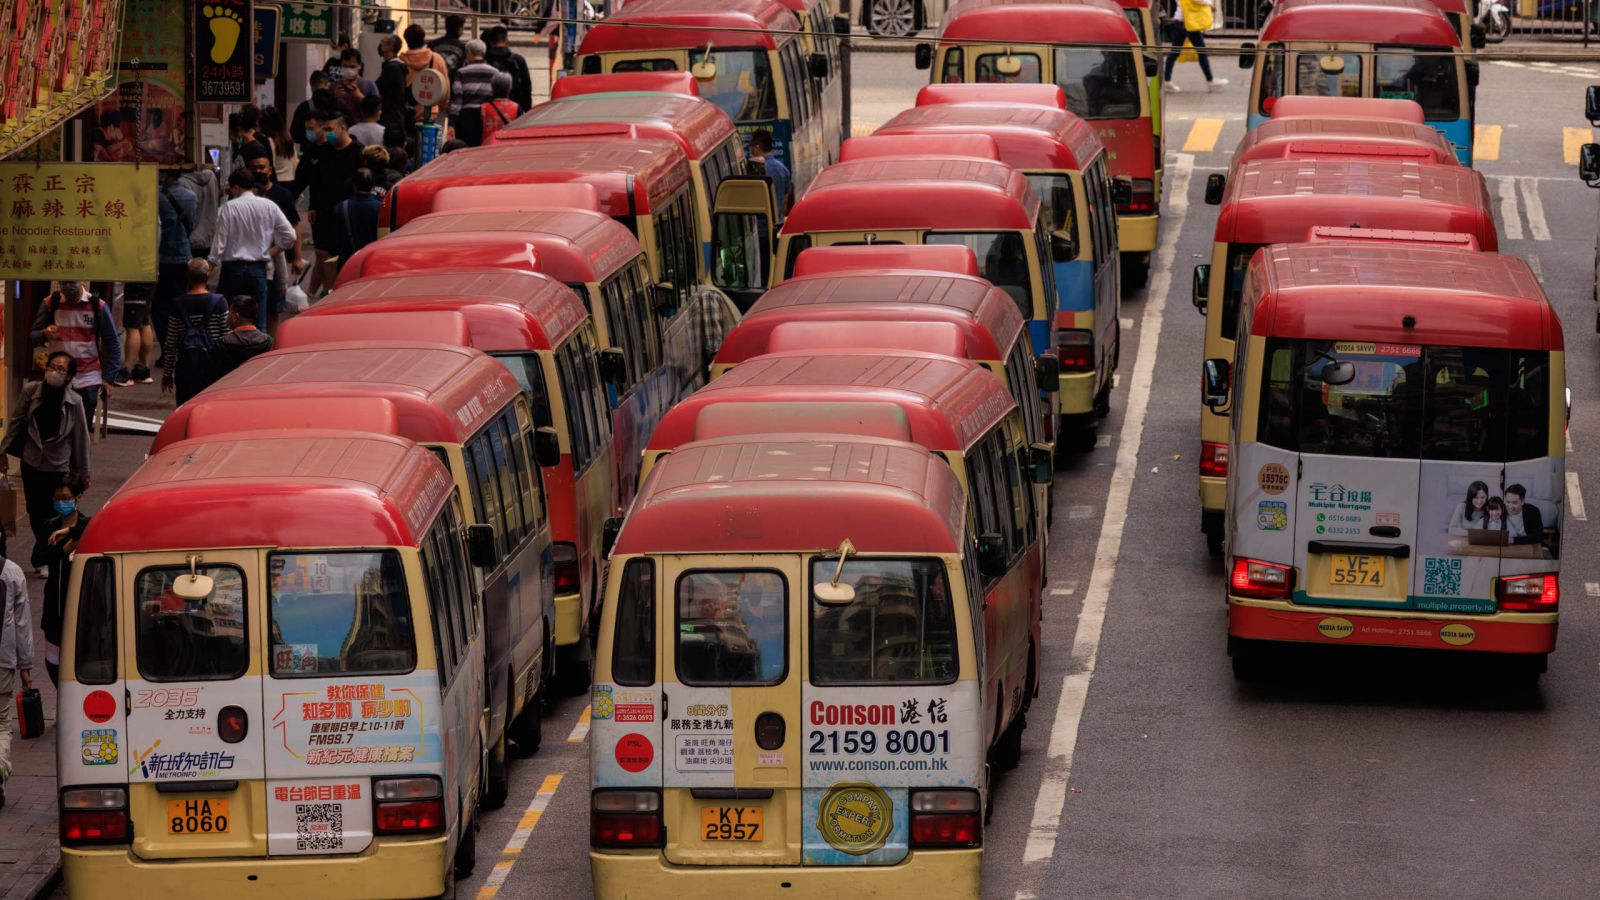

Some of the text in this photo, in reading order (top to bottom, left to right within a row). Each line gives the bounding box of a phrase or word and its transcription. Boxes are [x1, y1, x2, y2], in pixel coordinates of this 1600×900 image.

[202, 64, 245, 79] 24小時
[202, 80, 245, 96] 36739591
[10, 198, 128, 219] 麻辣米線
[12, 225, 50, 236] Noodle
[53, 226, 112, 237] Restaurant
[1308, 501, 1371, 511] Multiple Mortgage
[1348, 556, 1370, 570] VF
[1335, 570, 1380, 584] 5574
[327, 684, 385, 701] 教你保健
[164, 709, 206, 720] 全力支持
[810, 698, 948, 725] Conson 港信
[308, 734, 354, 746] FM99.7
[809, 730, 950, 754] 2159 8001
[149, 751, 235, 778] 新城知訊台
[810, 758, 948, 771] www.conson.com.hk
[159, 771, 198, 779] METROINFO
[274, 784, 361, 801] 電台節目重溫
[185, 800, 212, 816] HA
[839, 793, 881, 820] COMPANY
[720, 807, 745, 823] KY
[836, 805, 876, 827] EXPERT
[171, 816, 227, 833] 8060
[706, 823, 759, 840] 2957
[830, 813, 874, 842] FORMATION
